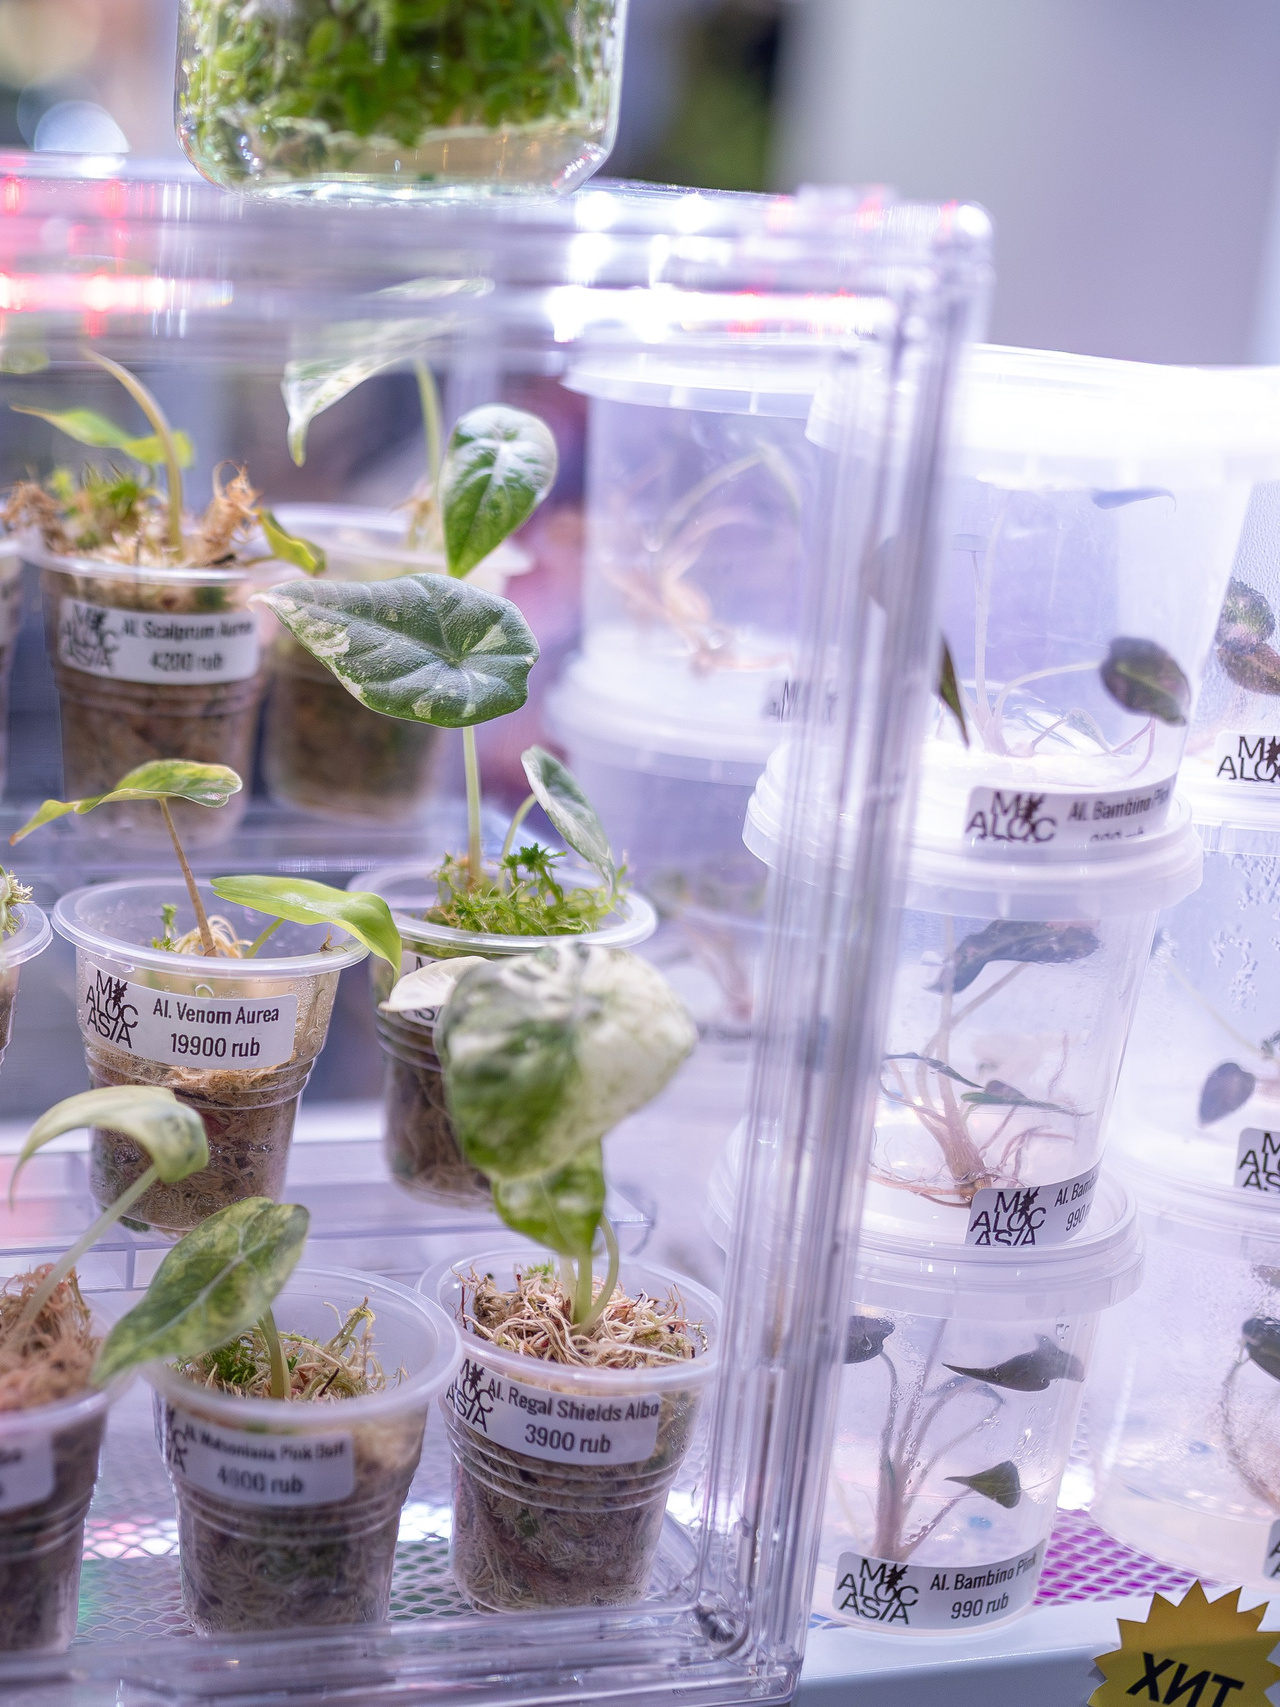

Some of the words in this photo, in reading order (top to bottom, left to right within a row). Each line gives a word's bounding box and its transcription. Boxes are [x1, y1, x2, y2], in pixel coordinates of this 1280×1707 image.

[1217, 756, 1280, 782] ALO
[965, 811, 1057, 842] ALOC
[86, 985, 139, 1029] ALOC
[153, 998, 172, 1019] Al.
[176, 1001, 232, 1025] Venom
[235, 1006, 280, 1025] Aurea
[87, 1007, 132, 1049] ASIA
[170, 1033, 227, 1058] 19900
[231, 1037, 261, 1058] rub
[970, 1207, 1047, 1232] ALOC
[488, 1378, 504, 1401] Al.
[509, 1386, 552, 1416] Regal
[557, 1401, 621, 1422] Shields
[625, 1401, 659, 1420] Albo
[524, 1423, 575, 1452] 3900
[579, 1433, 611, 1454] rub
[271, 1473, 304, 1494] rub
[837, 1573, 919, 1606] ALOC
[930, 1574, 949, 1591] Al.
[954, 1568, 1014, 1591] Bambino
[838, 1593, 910, 1625] ASIA
[951, 1599, 982, 1620] 990
[986, 1593, 1009, 1615] rub
[1126, 1652, 1244, 1707] ХИТ
